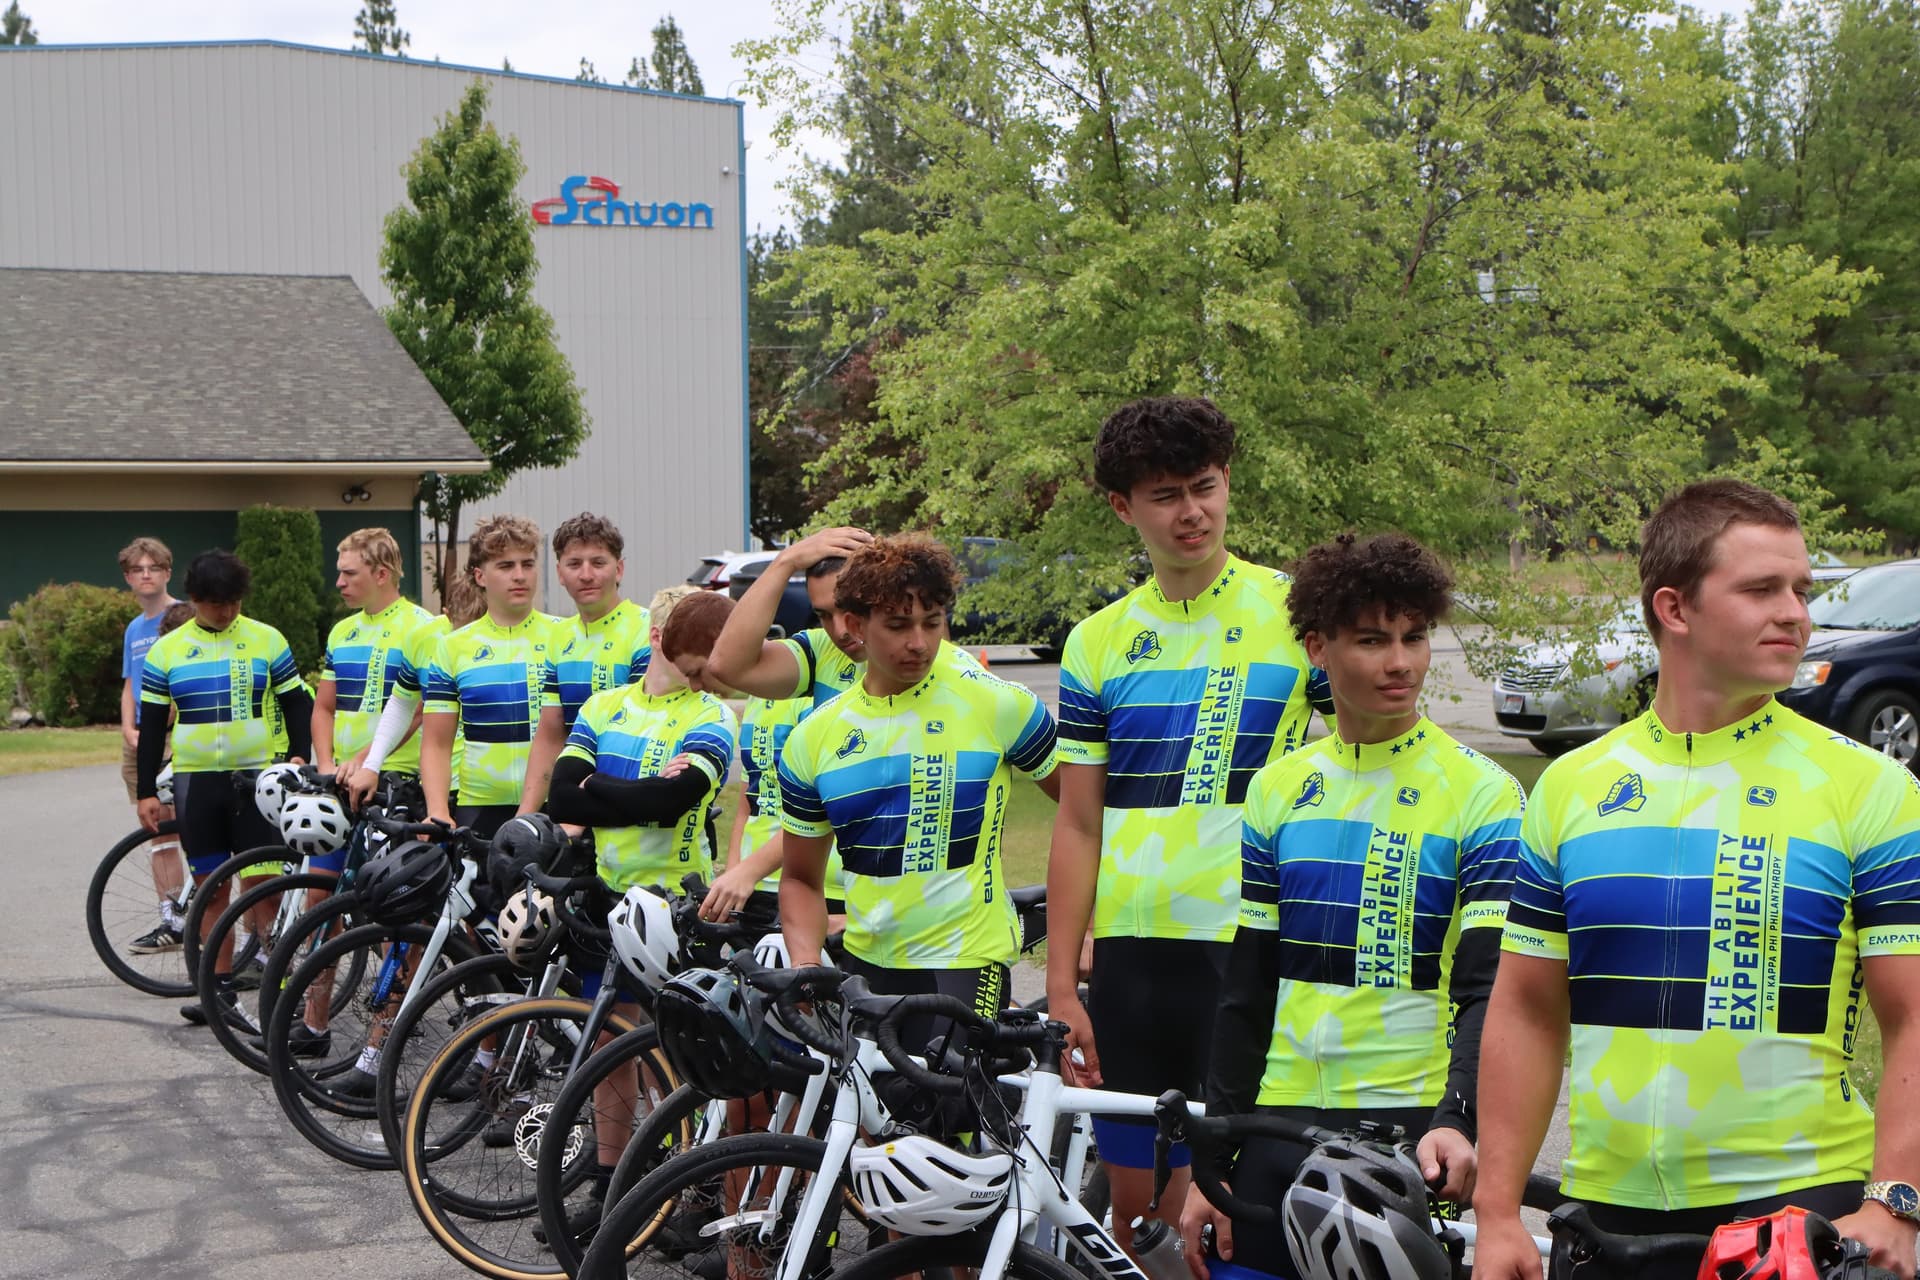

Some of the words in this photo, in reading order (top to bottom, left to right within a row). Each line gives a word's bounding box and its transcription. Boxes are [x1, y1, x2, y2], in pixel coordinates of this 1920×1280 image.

[551, 175, 713, 228] Schuon
[237, 658, 247, 720] EXPERIENCE
[1182, 766, 1199, 806] THE
[1194, 668, 1219, 751] ABILITY
[1195, 665, 1236, 805] EXPERIENCE
[1222, 749, 1231, 772] KAPPA
[1230, 678, 1244, 732] PHILANTHROPY
[910, 755, 925, 828] ABILITY
[918, 754, 943, 873] EXPERIENCE
[904, 841, 919, 875] THE
[1362, 827, 1387, 928] ABILITY
[1404, 850, 1417, 911] PHILANTHROPY
[1374, 831, 1407, 989] EXPERIENCE
[1713, 834, 1739, 953] ABILITY
[1769, 856, 1782, 931] PHILANTHROPY
[1730, 835, 1766, 1031] EXPERIENCE
[1769, 935, 1777, 952] PHI
[974, 968, 989, 1017] ABILIT
[983, 962, 1000, 1019] RIENCE
[1358, 944, 1373, 988] THE
[1767, 992, 1775, 1001] PI
[1768, 956, 1777, 988] KAPPA
[1707, 976, 1728, 1030] THE
